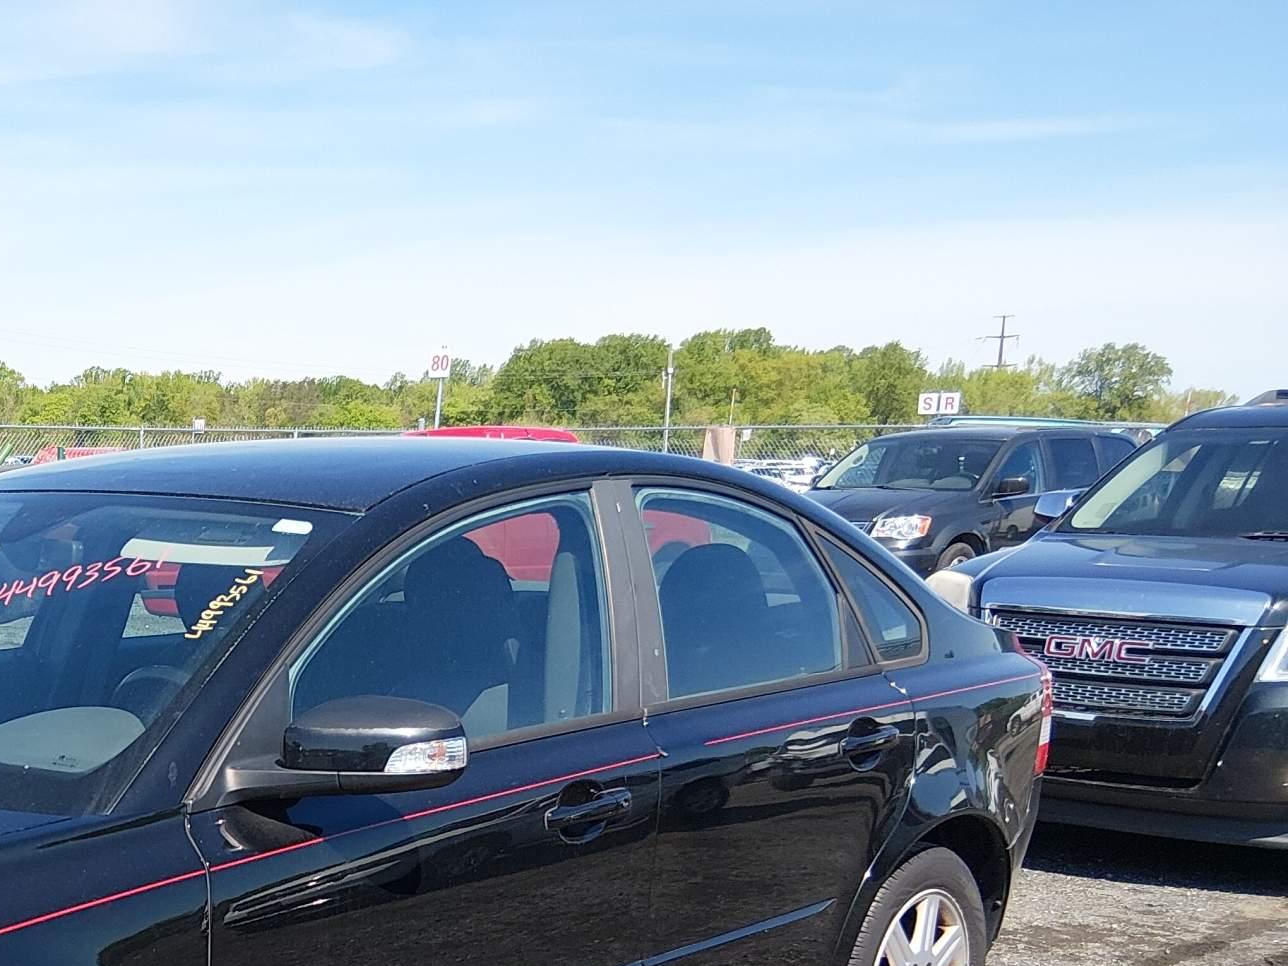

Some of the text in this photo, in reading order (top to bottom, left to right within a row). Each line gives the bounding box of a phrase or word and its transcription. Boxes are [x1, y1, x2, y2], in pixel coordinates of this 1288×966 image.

[431, 354, 449, 371] 80
[923, 397, 933, 411] S
[944, 396, 955, 411] R
[185, 568, 264, 640] 44993561
[1044, 634, 1153, 664] GMC
